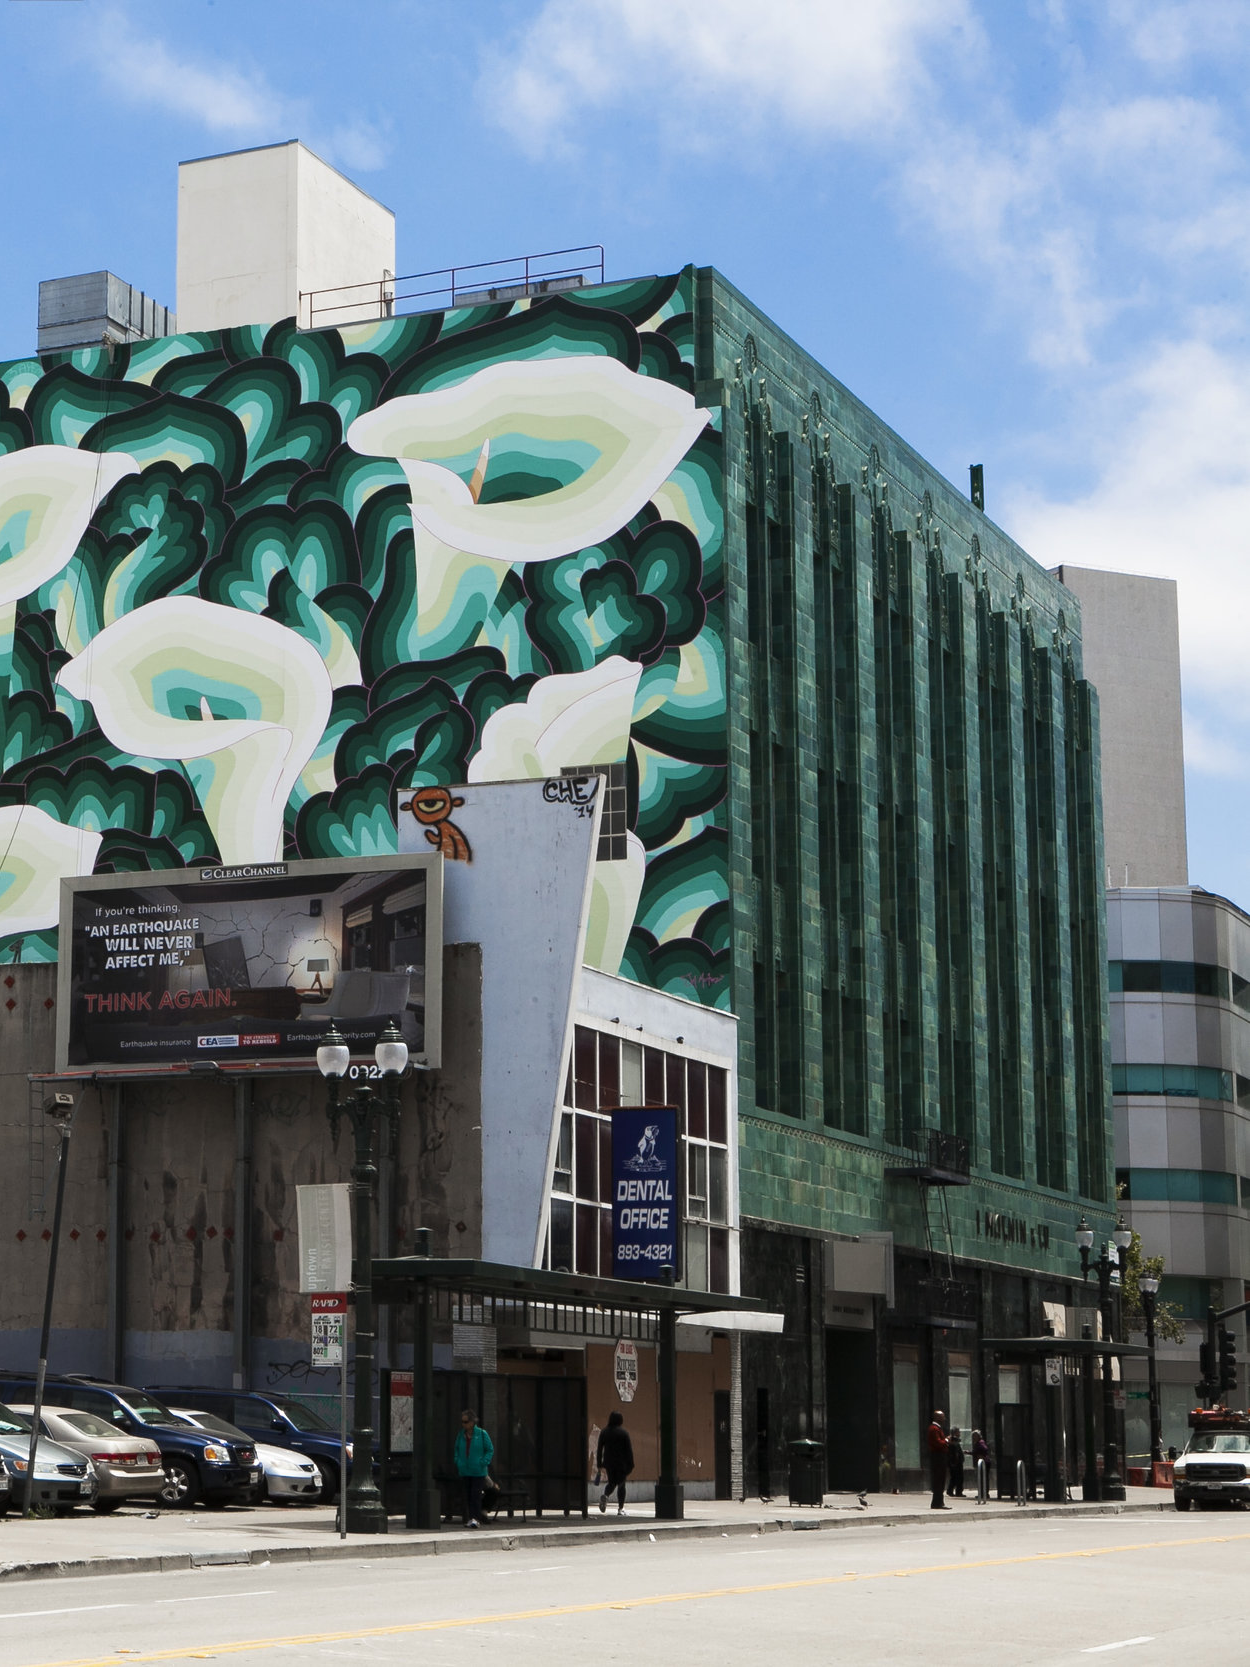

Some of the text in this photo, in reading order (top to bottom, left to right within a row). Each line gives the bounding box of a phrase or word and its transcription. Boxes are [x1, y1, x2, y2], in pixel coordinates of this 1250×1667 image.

[95, 908, 102, 917] If
[104, 907, 135, 918] you're
[112, 918, 200, 936] EARTHQUAKE
[105, 935, 193, 952] WILL NEVER
[105, 953, 155, 970] AFFECT
[84, 987, 237, 1013] THINK AGAIN.
[120, 1040, 158, 1048] Earthquake
[199, 1037, 219, 1046] CEA
[617, 1180, 672, 1201] DENTAL
[620, 1208, 670, 1229] OFFICE
[617, 1244, 672, 1260] 893-4321
[306, 1248, 326, 1290] uptown
[312, 1299, 339, 1308] RAPID
[315, 1325, 338, 1334] 18 72
[313, 1347, 323, 1355] 802
